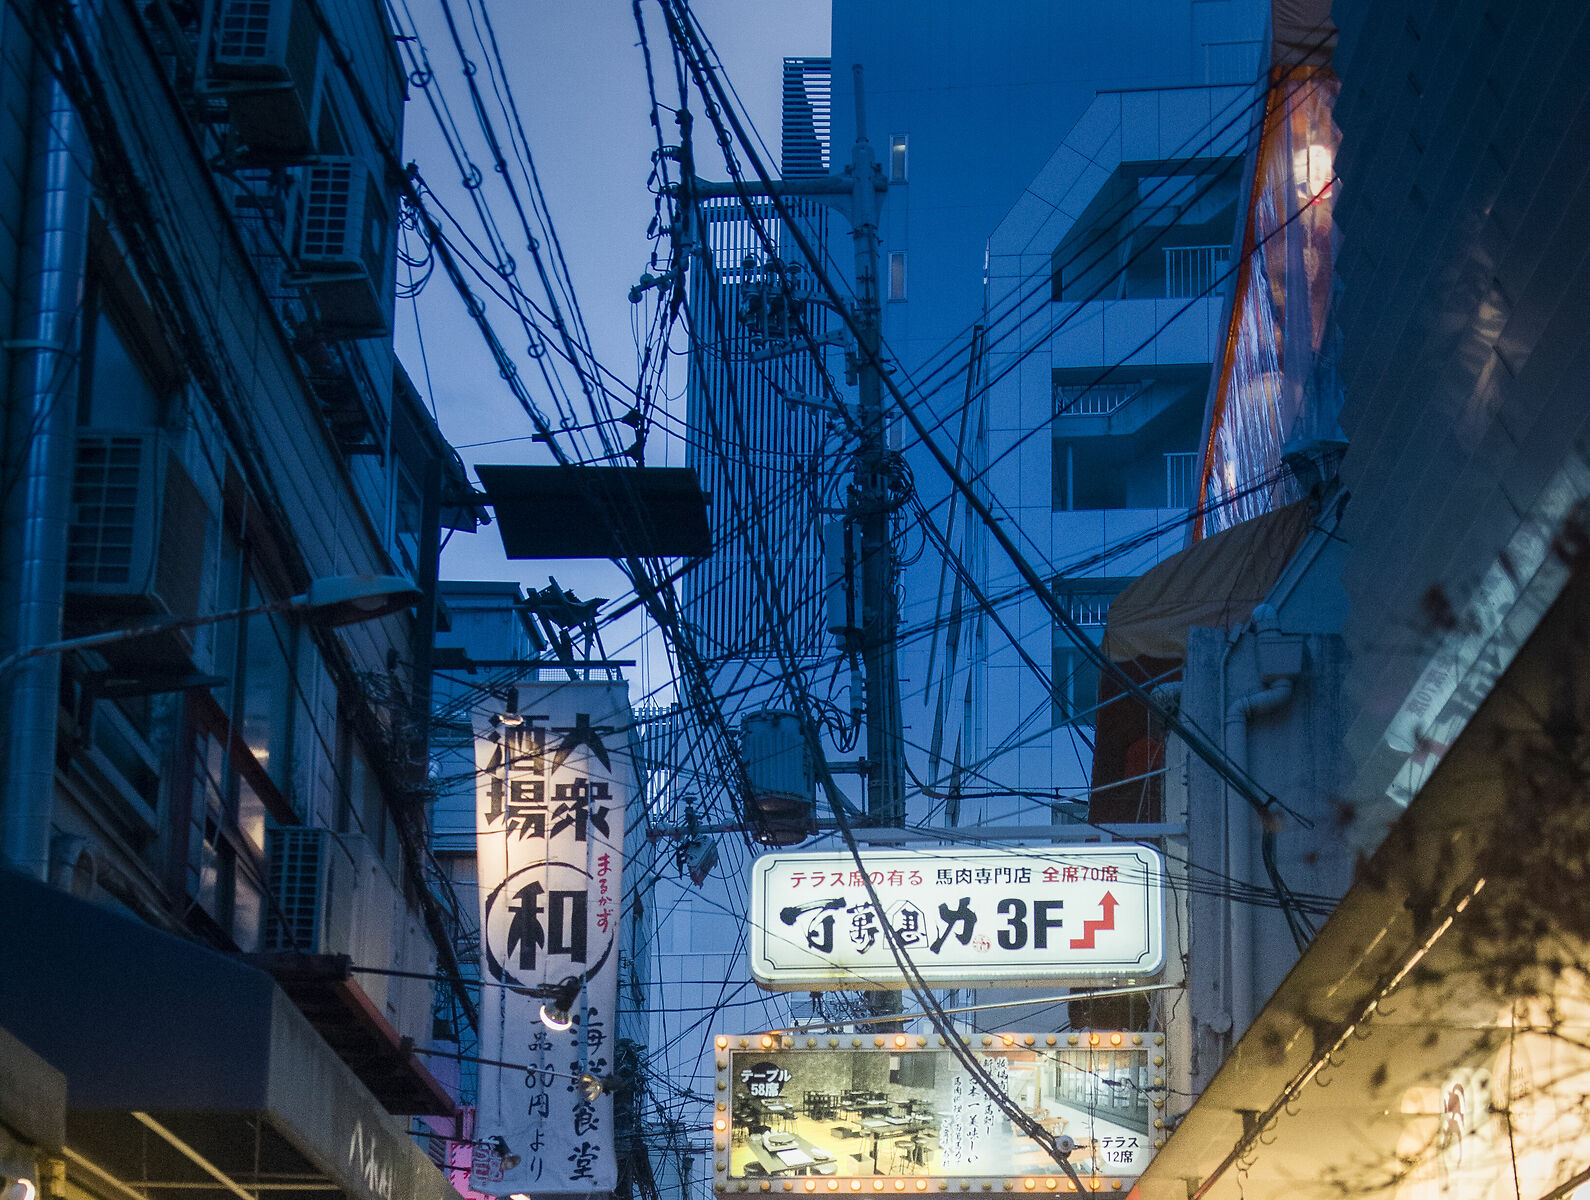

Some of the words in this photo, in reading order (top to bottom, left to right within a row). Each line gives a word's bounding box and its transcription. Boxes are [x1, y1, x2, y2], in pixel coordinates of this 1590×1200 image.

[485, 715, 549, 841] 酒場
[551, 713, 614, 841] 大衆
[597, 853, 613, 932] まるかず
[790, 869, 924, 888] テラス席の有る
[935, 867, 1031, 886] 馬肉専門店
[1042, 865, 1119, 884] 全席70席
[507, 880, 588, 970] 和
[997, 898, 1064, 951] 3F
[751, 1082, 779, 1097] 58席
[1102, 1136, 1139, 1149] テラス
[1107, 1151, 1134, 1164] 12席
